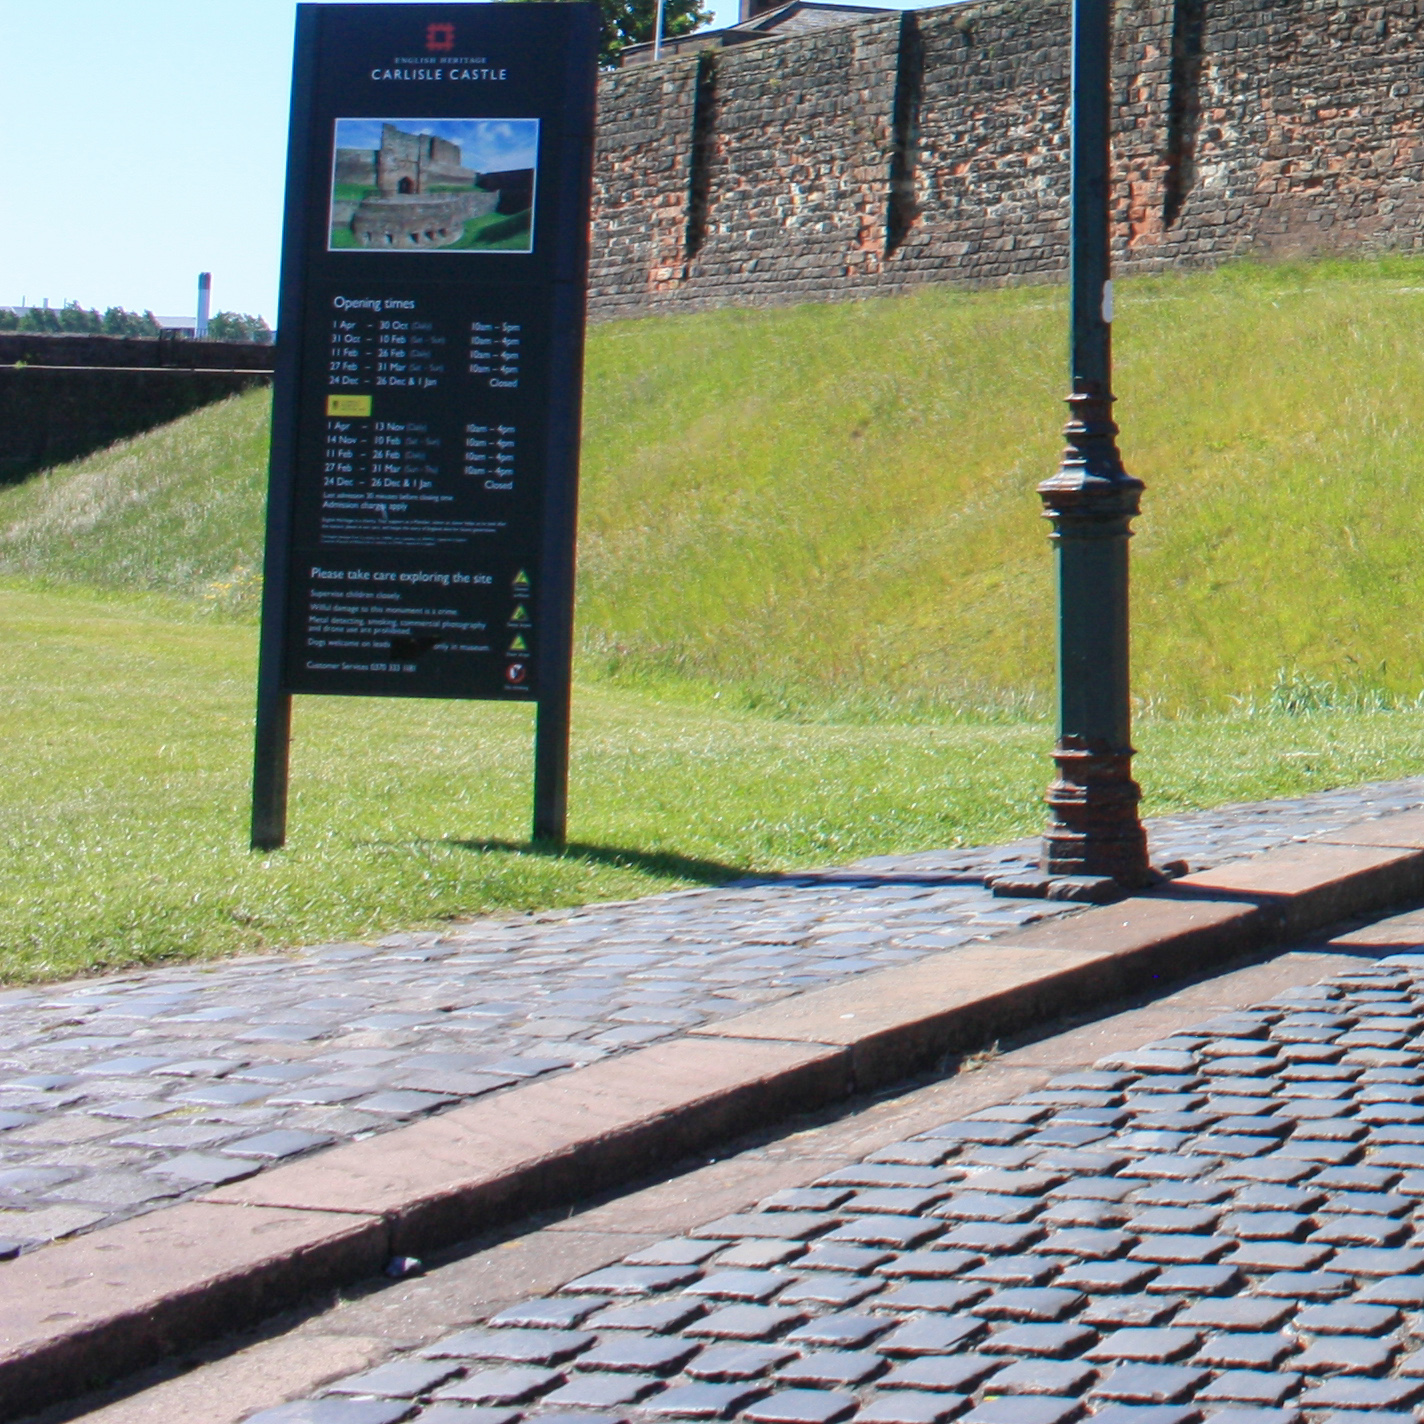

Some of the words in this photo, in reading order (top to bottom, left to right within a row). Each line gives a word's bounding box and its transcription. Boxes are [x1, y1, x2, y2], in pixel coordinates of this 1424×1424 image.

[371, 69, 443, 80] CARLISLE
[449, 69, 507, 80] CASTLE
[334, 296, 382, 312] Opening
[384, 297, 415, 309] times
[339, 321, 356, 331] Apr
[392, 321, 409, 330] Oct
[471, 322, 493, 331] 10am
[331, 334, 341, 343] 31
[344, 334, 361, 344] Oct
[380, 335, 390, 344] 10
[391, 335, 407, 344] Feb
[471, 336, 492, 345] 10am
[502, 337, 520, 347] 4pm
[332, 348, 340, 357] 11
[343, 348, 359, 357] Feb
[378, 348, 389, 358] 26
[390, 349, 406, 358] Feb
[470, 350, 491, 359] 10am
[500, 351, 519, 361] 4pm
[329, 361, 341, 371] 27
[342, 361, 358, 371] Feb
[377, 362, 387, 372] 31
[390, 362, 406, 372] Mar
[469, 363, 491, 373] 10am
[500, 364, 519, 375] 4pm
[329, 376, 340, 385] 24
[342, 376, 359, 385] Dec
[376, 376, 387, 386] 26
[389, 376, 406, 386] Dec
[408, 377, 415, 386] &
[423, 377, 438, 388] Jan
[489, 378, 519, 388] Closed
[334, 421, 351, 432] Apr
[375, 422, 385, 431] 13
[386, 422, 406, 431] Nov
[496, 425, 516, 435] 4pm
[327, 435, 337, 444] 14
[338, 436, 358, 444] Nov
[386, 436, 401, 445] Feb
[496, 439, 515, 449] 4pm
[338, 449, 353, 459] Feb
[372, 449, 384, 459] 26
[385, 450, 401, 459] Feb
[496, 452, 514, 463] 4pm
[325, 463, 336, 472] 27
[337, 463, 353, 472] Feb
[372, 464, 381, 473] 31
[384, 464, 401, 473] Mar
[495, 466, 514, 477] 4pm
[324, 477, 335, 486] 24
[336, 477, 354, 487] Dec
[371, 478, 382, 487] 26
[384, 478, 401, 487] Dec
[403, 479, 410, 487] &
[418, 479, 433, 490] Jan
[484, 480, 514, 490] Closed
[323, 501, 359, 509] Admission
[388, 502, 408, 512] apply
[311, 567, 344, 579] Please
[347, 569, 370, 580] take
[373, 572, 397, 581] care
[399, 571, 450, 586] exploring
[452, 571, 470, 583] the
[473, 573, 493, 584] site
[441, 621, 487, 631] photography
[306, 660, 340, 670] Customer
[341, 662, 369, 671] Services
